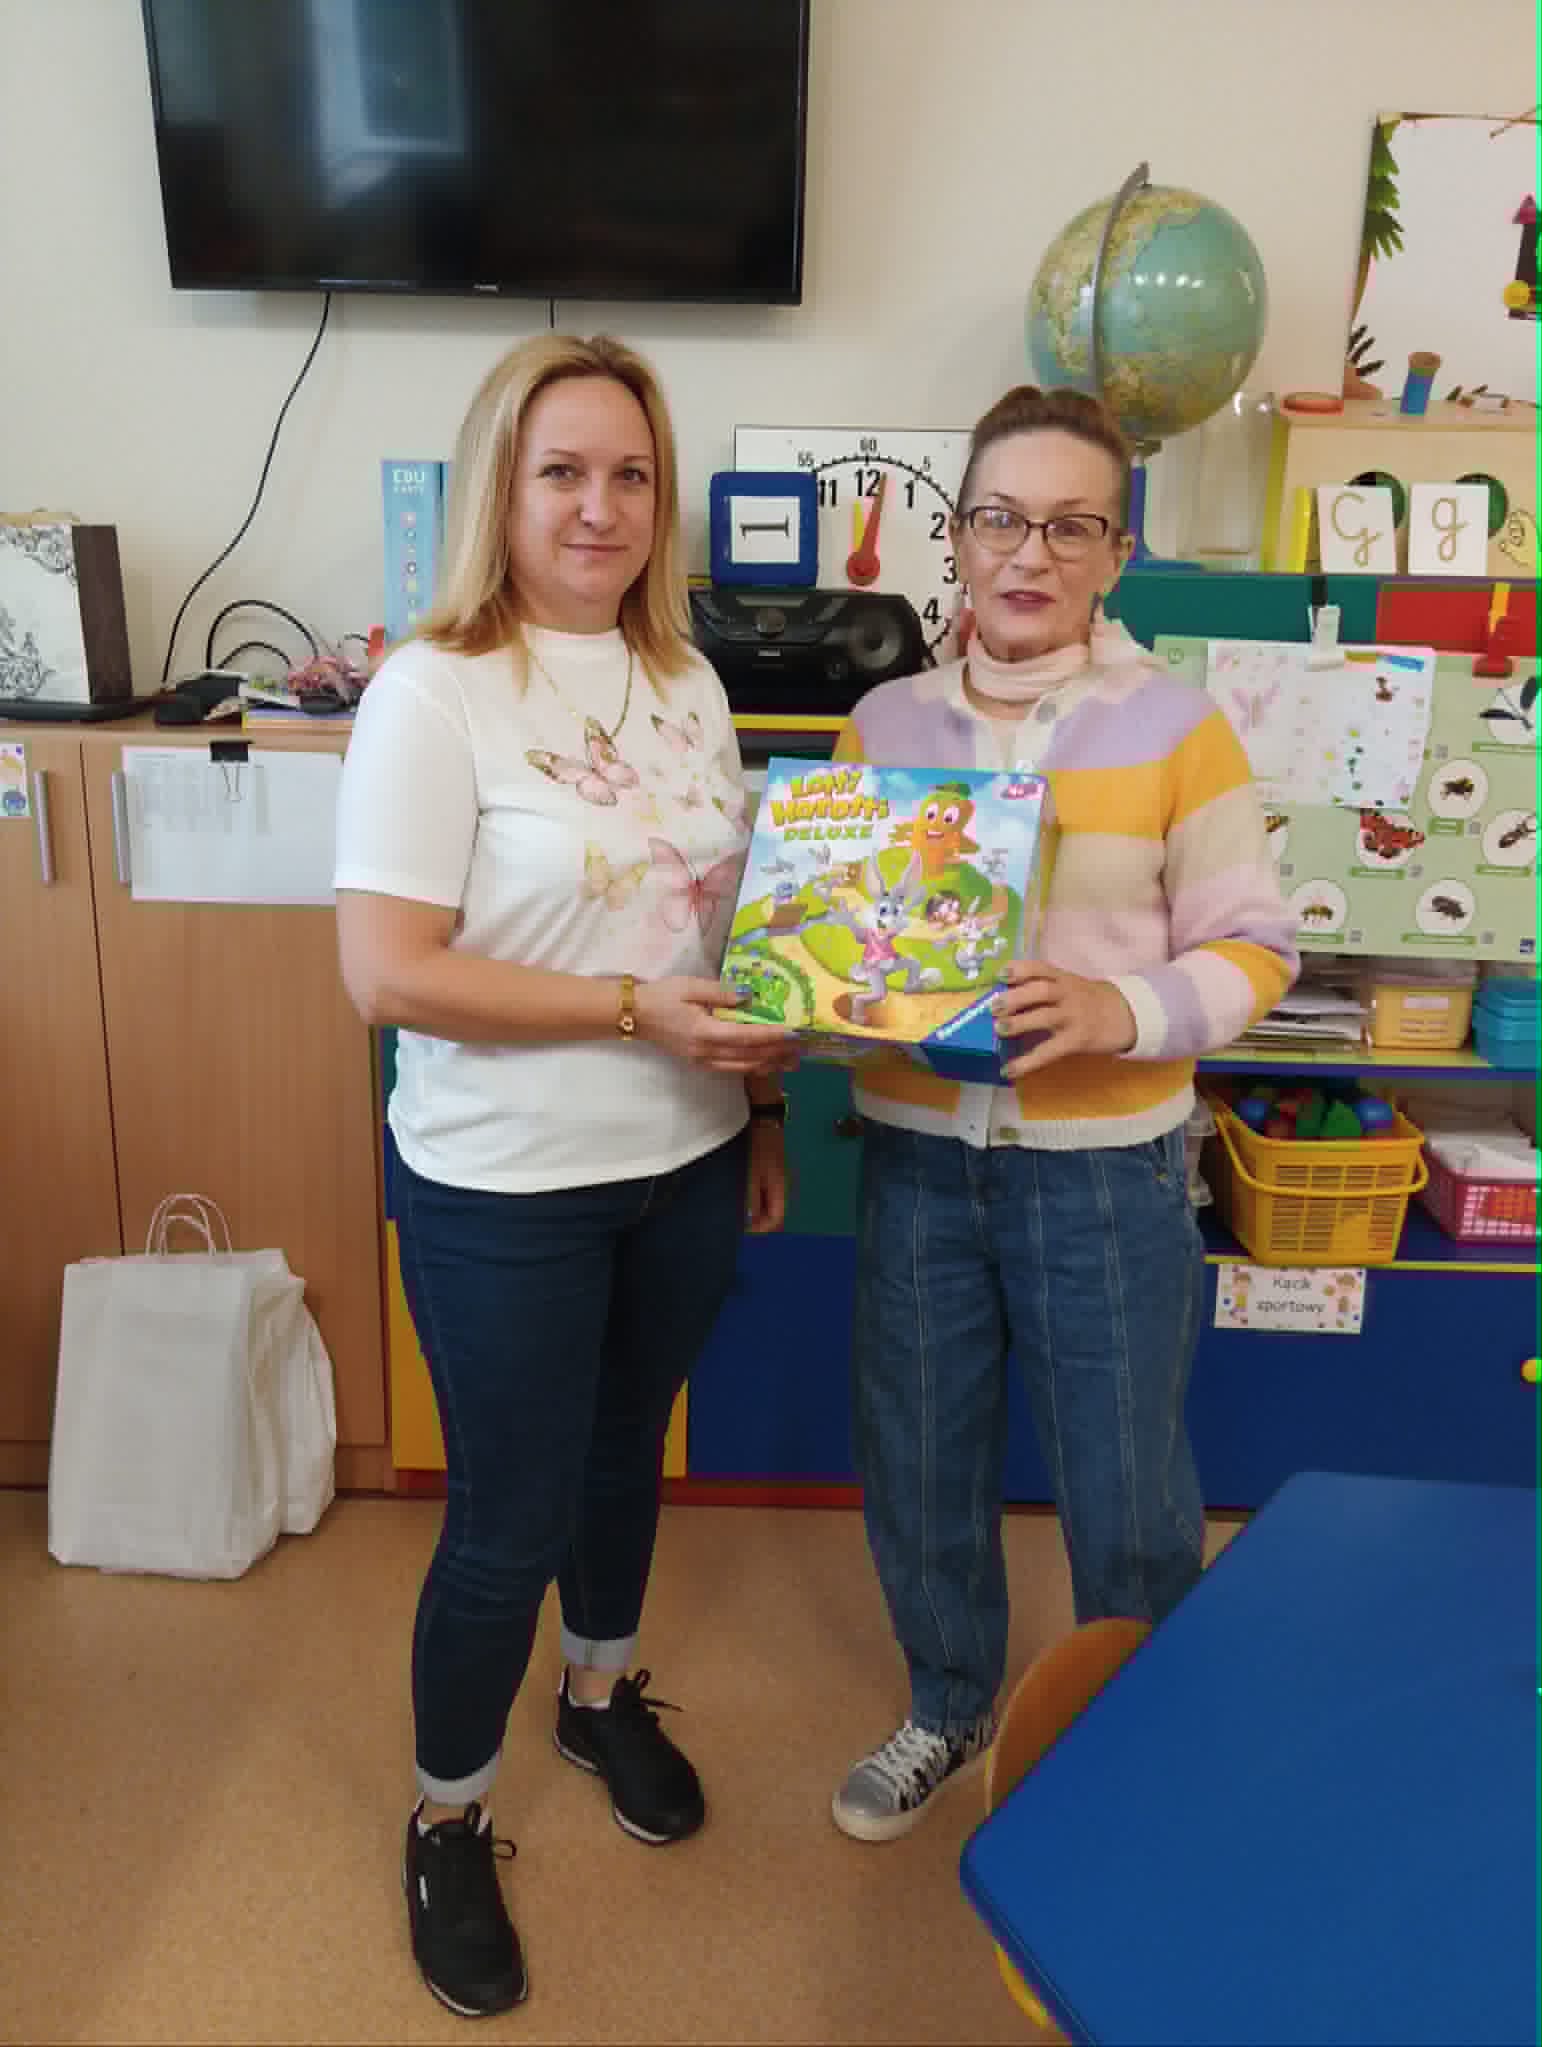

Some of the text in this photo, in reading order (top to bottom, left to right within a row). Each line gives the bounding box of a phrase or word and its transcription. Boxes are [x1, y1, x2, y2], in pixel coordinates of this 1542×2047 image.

[819, 479, 838, 508] 11
[855, 469, 881, 497] 12
[904, 479, 915, 509] 1
[929, 511, 946, 540] 2
[1331, 491, 1470, 567] G g
[942, 557, 958, 585] 3
[922, 598, 942, 625] 4
